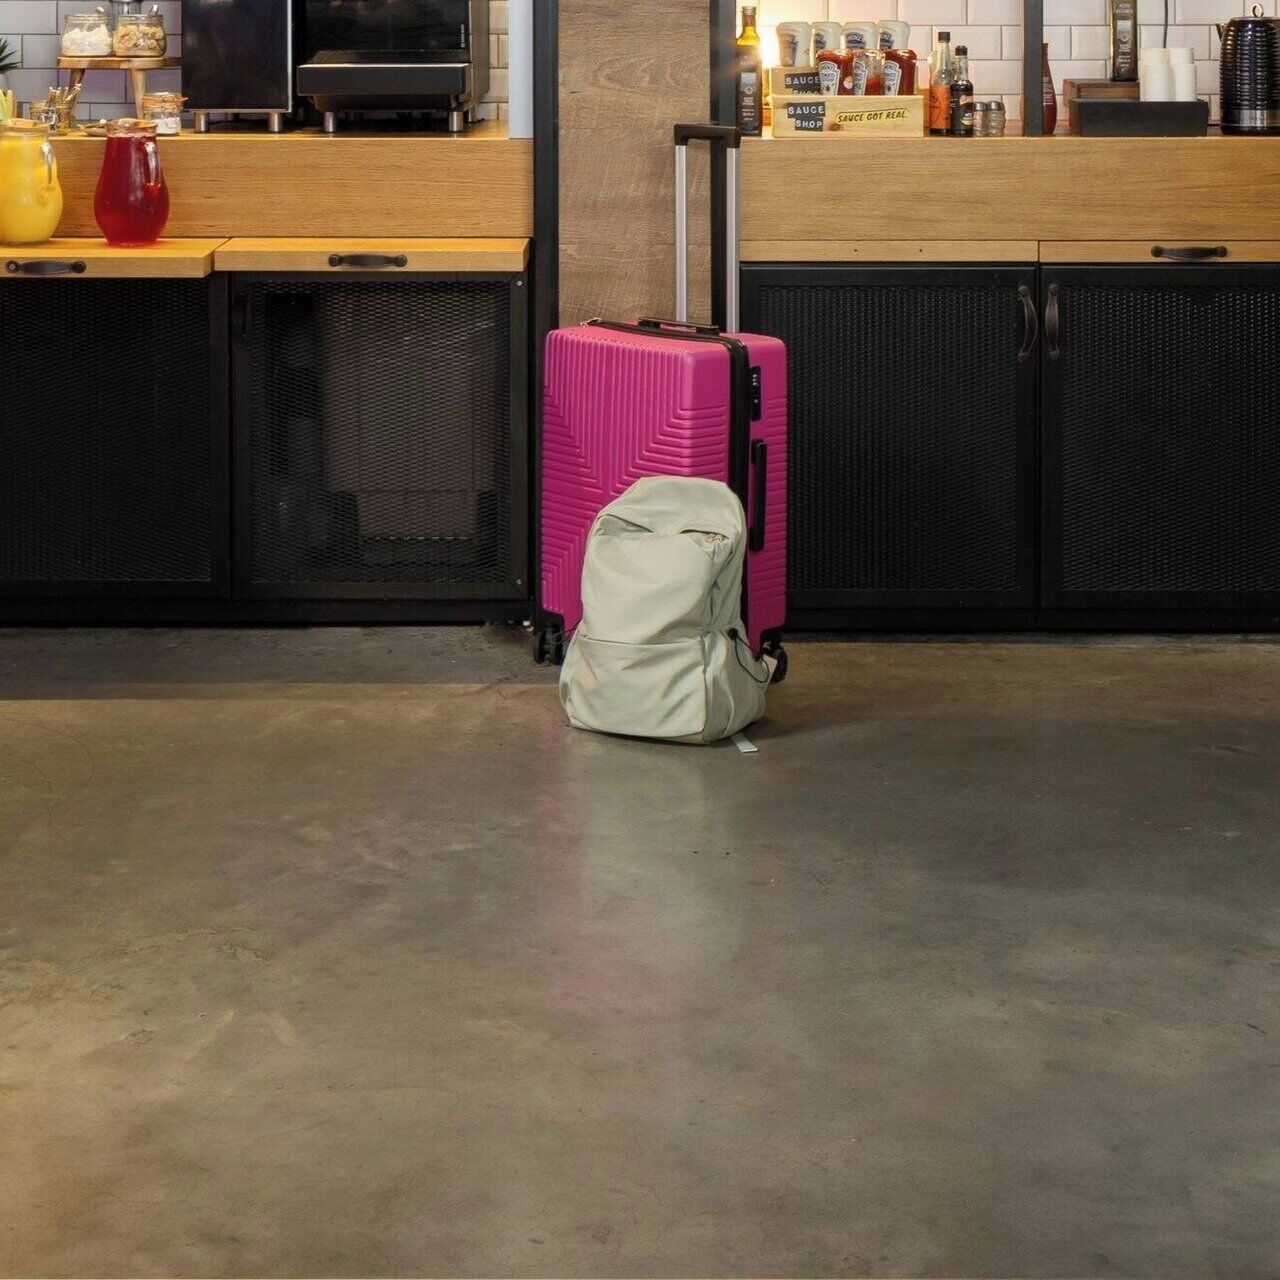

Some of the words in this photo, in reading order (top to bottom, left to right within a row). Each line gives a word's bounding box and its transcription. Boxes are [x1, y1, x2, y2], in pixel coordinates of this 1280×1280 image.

[785, 76, 819, 86] SAUCE
[788, 105, 825, 115] SAUCE
[838, 112, 864, 122] SAUCE
[866, 111, 883, 120] GOT
[795, 120, 823, 128] SHOP
